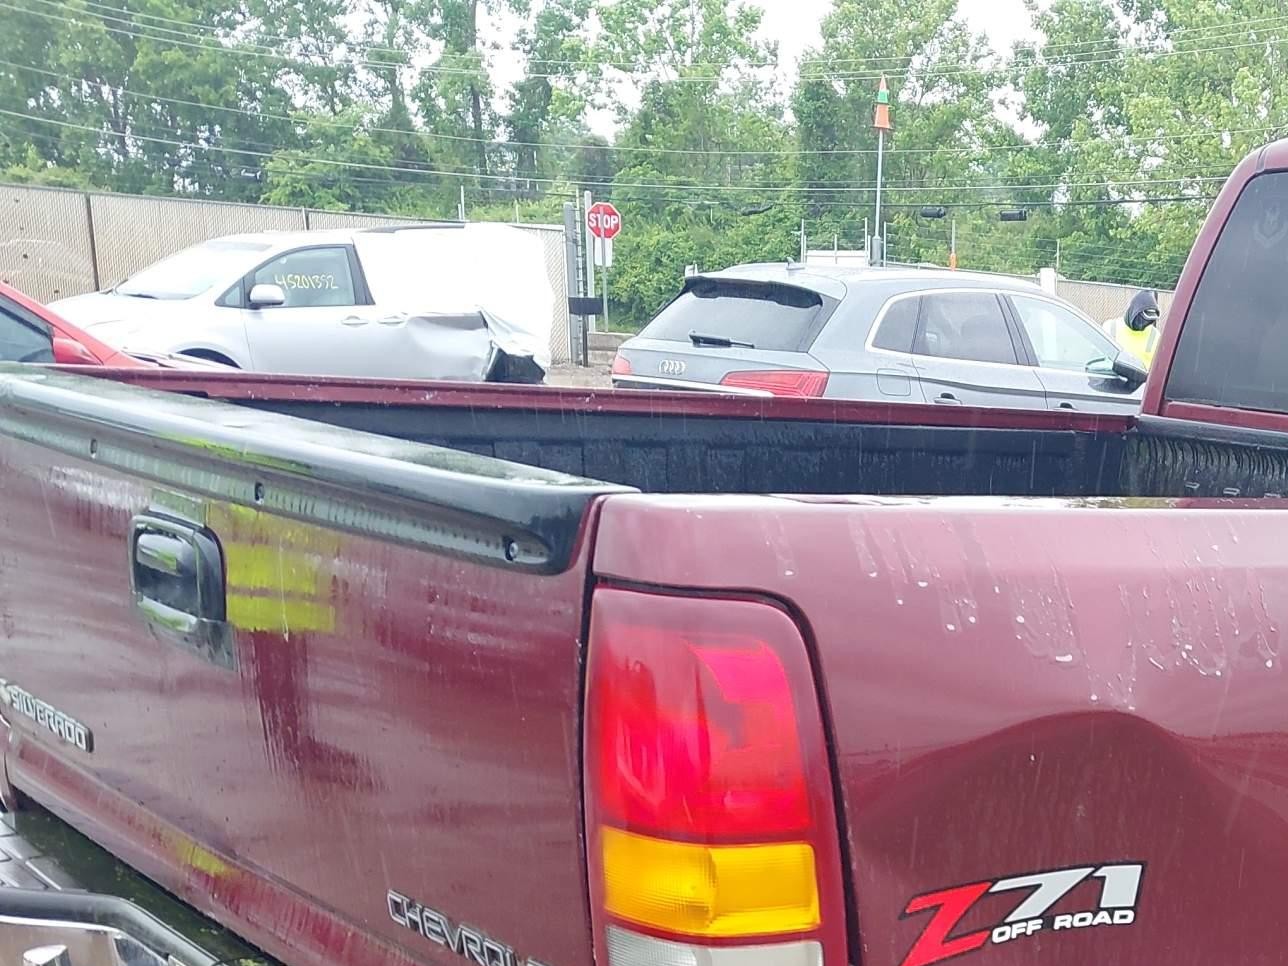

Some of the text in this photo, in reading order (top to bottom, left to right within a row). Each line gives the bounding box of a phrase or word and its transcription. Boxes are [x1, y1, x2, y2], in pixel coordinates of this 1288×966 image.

[588, 213, 619, 230] STOP
[9, 686, 90, 751] SILVERADO
[990, 908, 1136, 945] OFF ROAD
